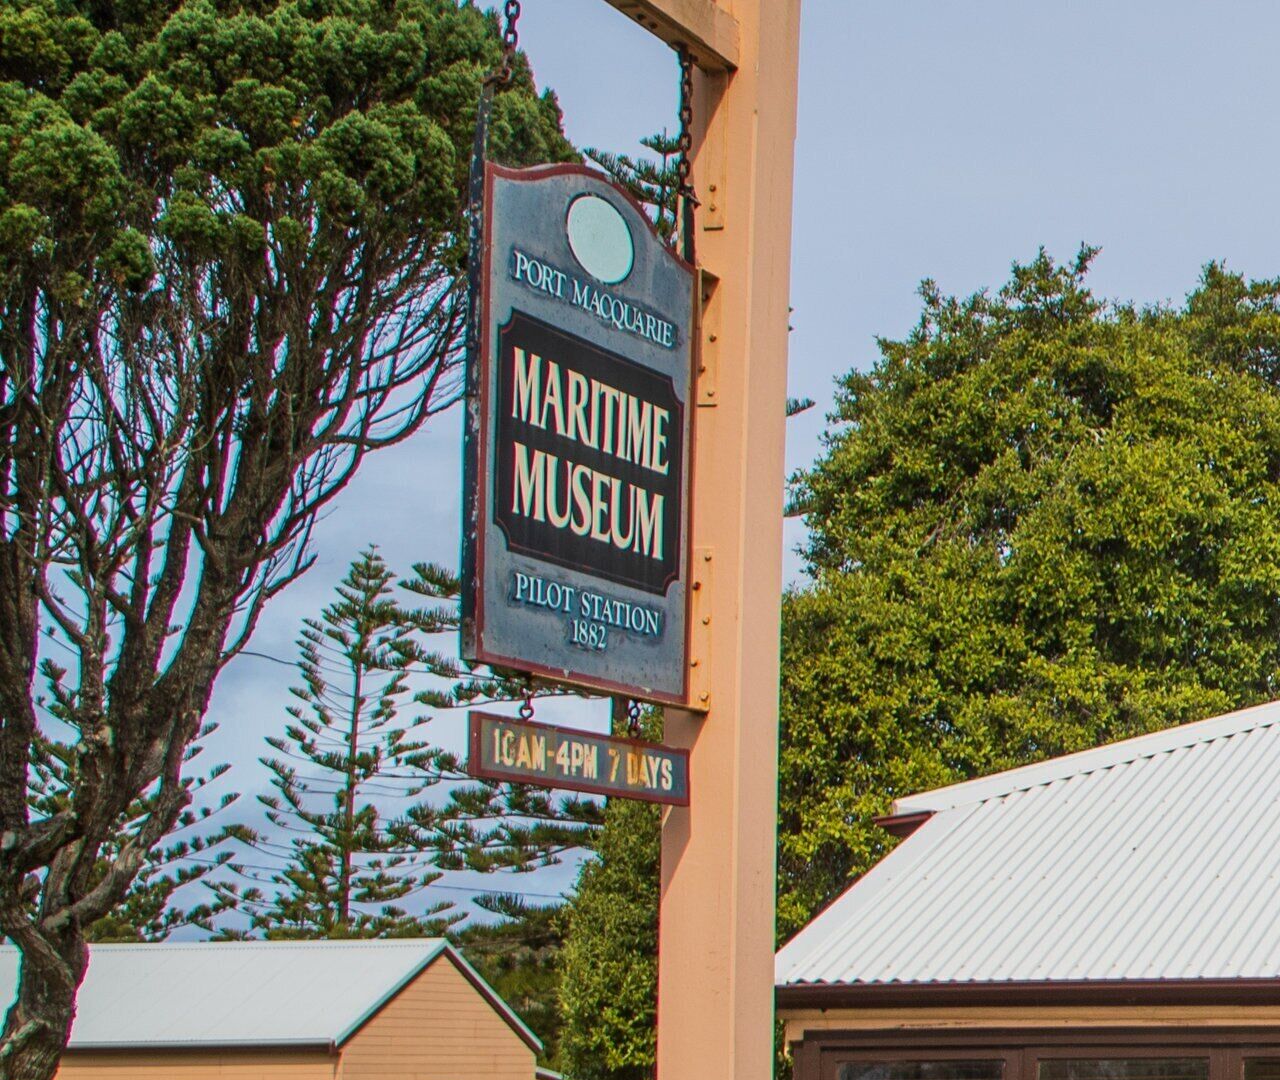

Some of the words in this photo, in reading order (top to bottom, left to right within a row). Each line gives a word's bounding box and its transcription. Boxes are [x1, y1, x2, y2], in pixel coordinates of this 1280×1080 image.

[514, 250, 567, 298] PORT
[572, 279, 673, 347] MACQUARIE
[512, 346, 669, 476] MARITIME
[512, 441, 665, 561] MUSEUM
[516, 573, 574, 612] PILOT
[581, 592, 659, 635] STATION
[571, 620, 607, 648] 1882
[608, 749, 621, 783] 7
[626, 751, 673, 791] DAYS
